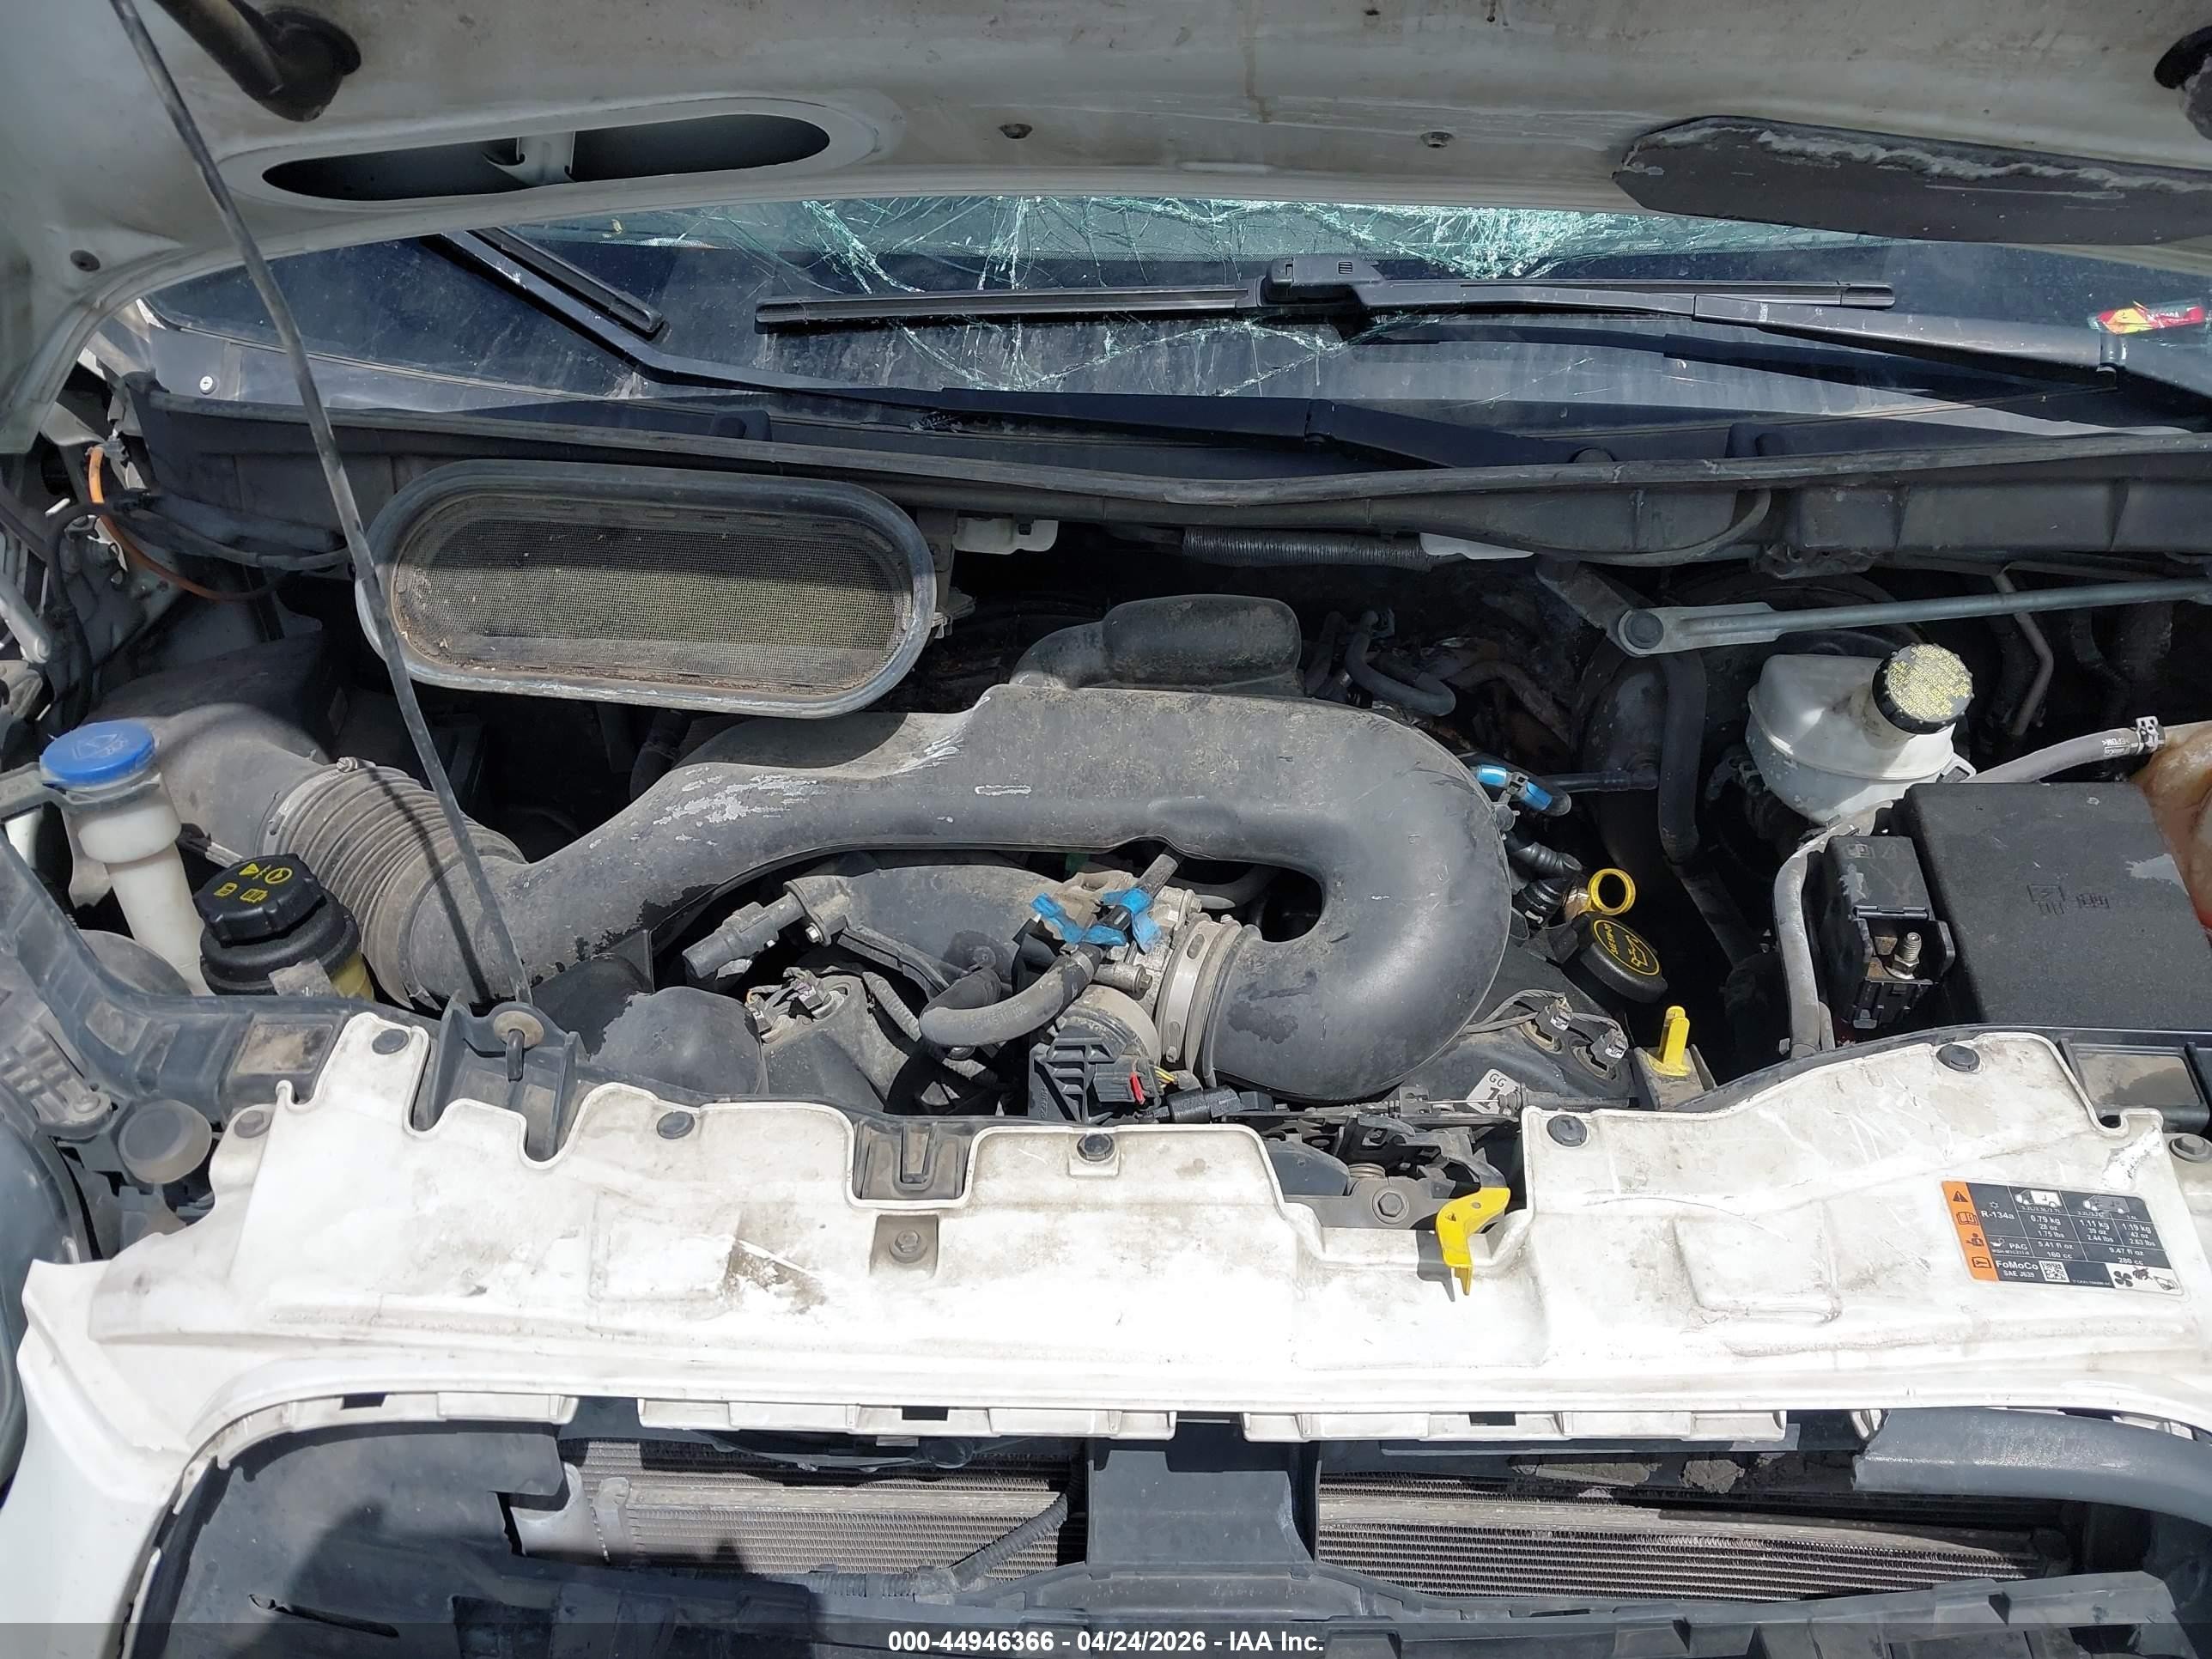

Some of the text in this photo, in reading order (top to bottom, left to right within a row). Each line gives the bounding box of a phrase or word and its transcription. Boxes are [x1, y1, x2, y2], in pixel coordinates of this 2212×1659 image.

[1926, 643, 1943, 659] CLEAN
[1958, 672, 1971, 684] CAP
[1941, 647, 1966, 671] WARNING
[1489, 1073, 1507, 1087] GG
[1981, 1211, 2014, 1219] R-134a
[2050, 1215, 2061, 1225] kg
[2098, 1221, 2110, 1231] kg
[2140, 1224, 2152, 1234] kg
[1995, 1260, 2039, 1271] FoMoCo
